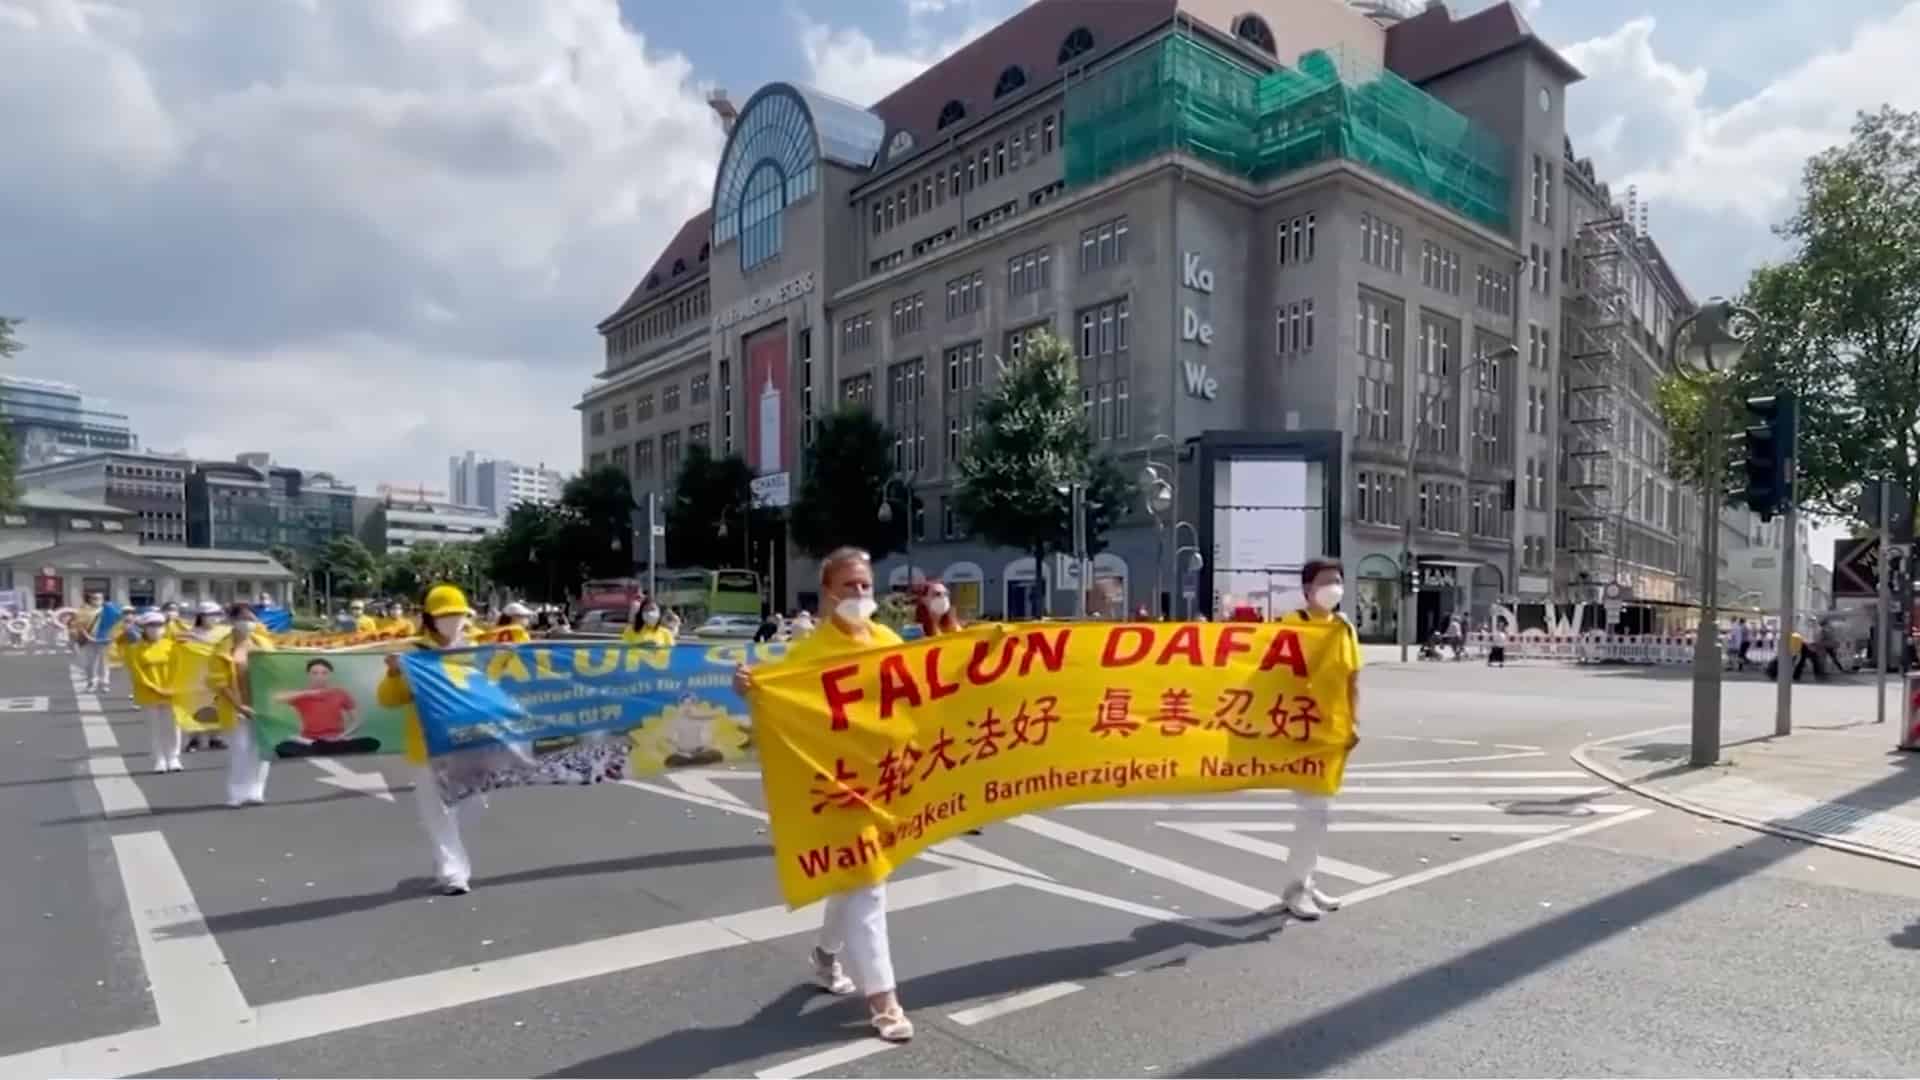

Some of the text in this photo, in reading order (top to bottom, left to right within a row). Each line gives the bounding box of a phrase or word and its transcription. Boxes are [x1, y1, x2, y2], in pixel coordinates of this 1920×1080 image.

[1183, 252, 1214, 292] Ka
[1183, 305, 1214, 345] De
[1183, 360, 1217, 399] We
[441, 643, 672, 689] FALUN
[822, 626, 1309, 731] FALUN DAFA
[985, 757, 1179, 804] Barmherzigkeit
